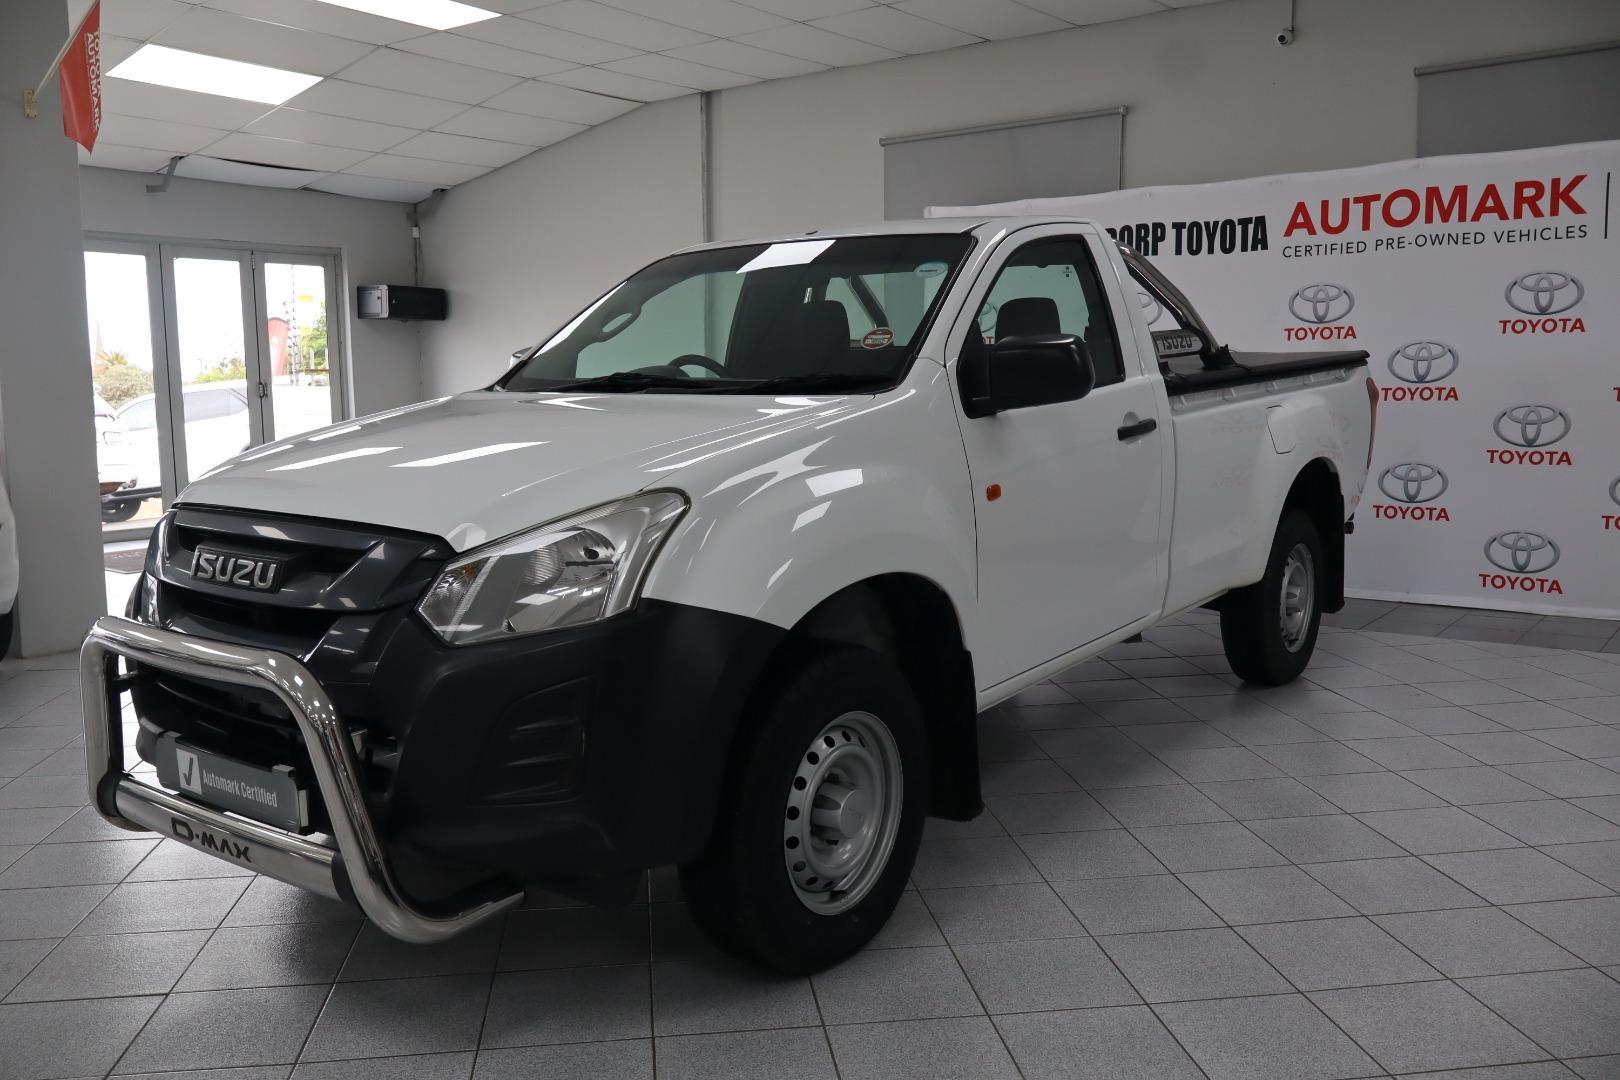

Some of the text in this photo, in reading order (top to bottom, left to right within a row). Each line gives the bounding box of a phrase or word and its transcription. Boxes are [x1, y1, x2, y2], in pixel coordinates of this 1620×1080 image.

[87, 32, 100, 131] AUTOMARK
[1283, 174, 1588, 237] AUTOMARK
[1171, 215, 1269, 256] TOYOTA
[1282, 224, 1588, 258] CERTIFIED PRE-OWNED VEHICLES
[1284, 325, 1357, 342] TOYOTA
[1499, 316, 1586, 335] TOYOTA
[1161, 335, 1193, 351] ISUZU
[1381, 386, 1459, 402] TOYOTA
[1487, 448, 1573, 466] TOYOTA
[1373, 504, 1450, 522] TOYOTA
[190, 549, 277, 589] ISUZU
[1479, 573, 1563, 594] TOYOTA
[202, 769, 278, 808] Automark Certified
